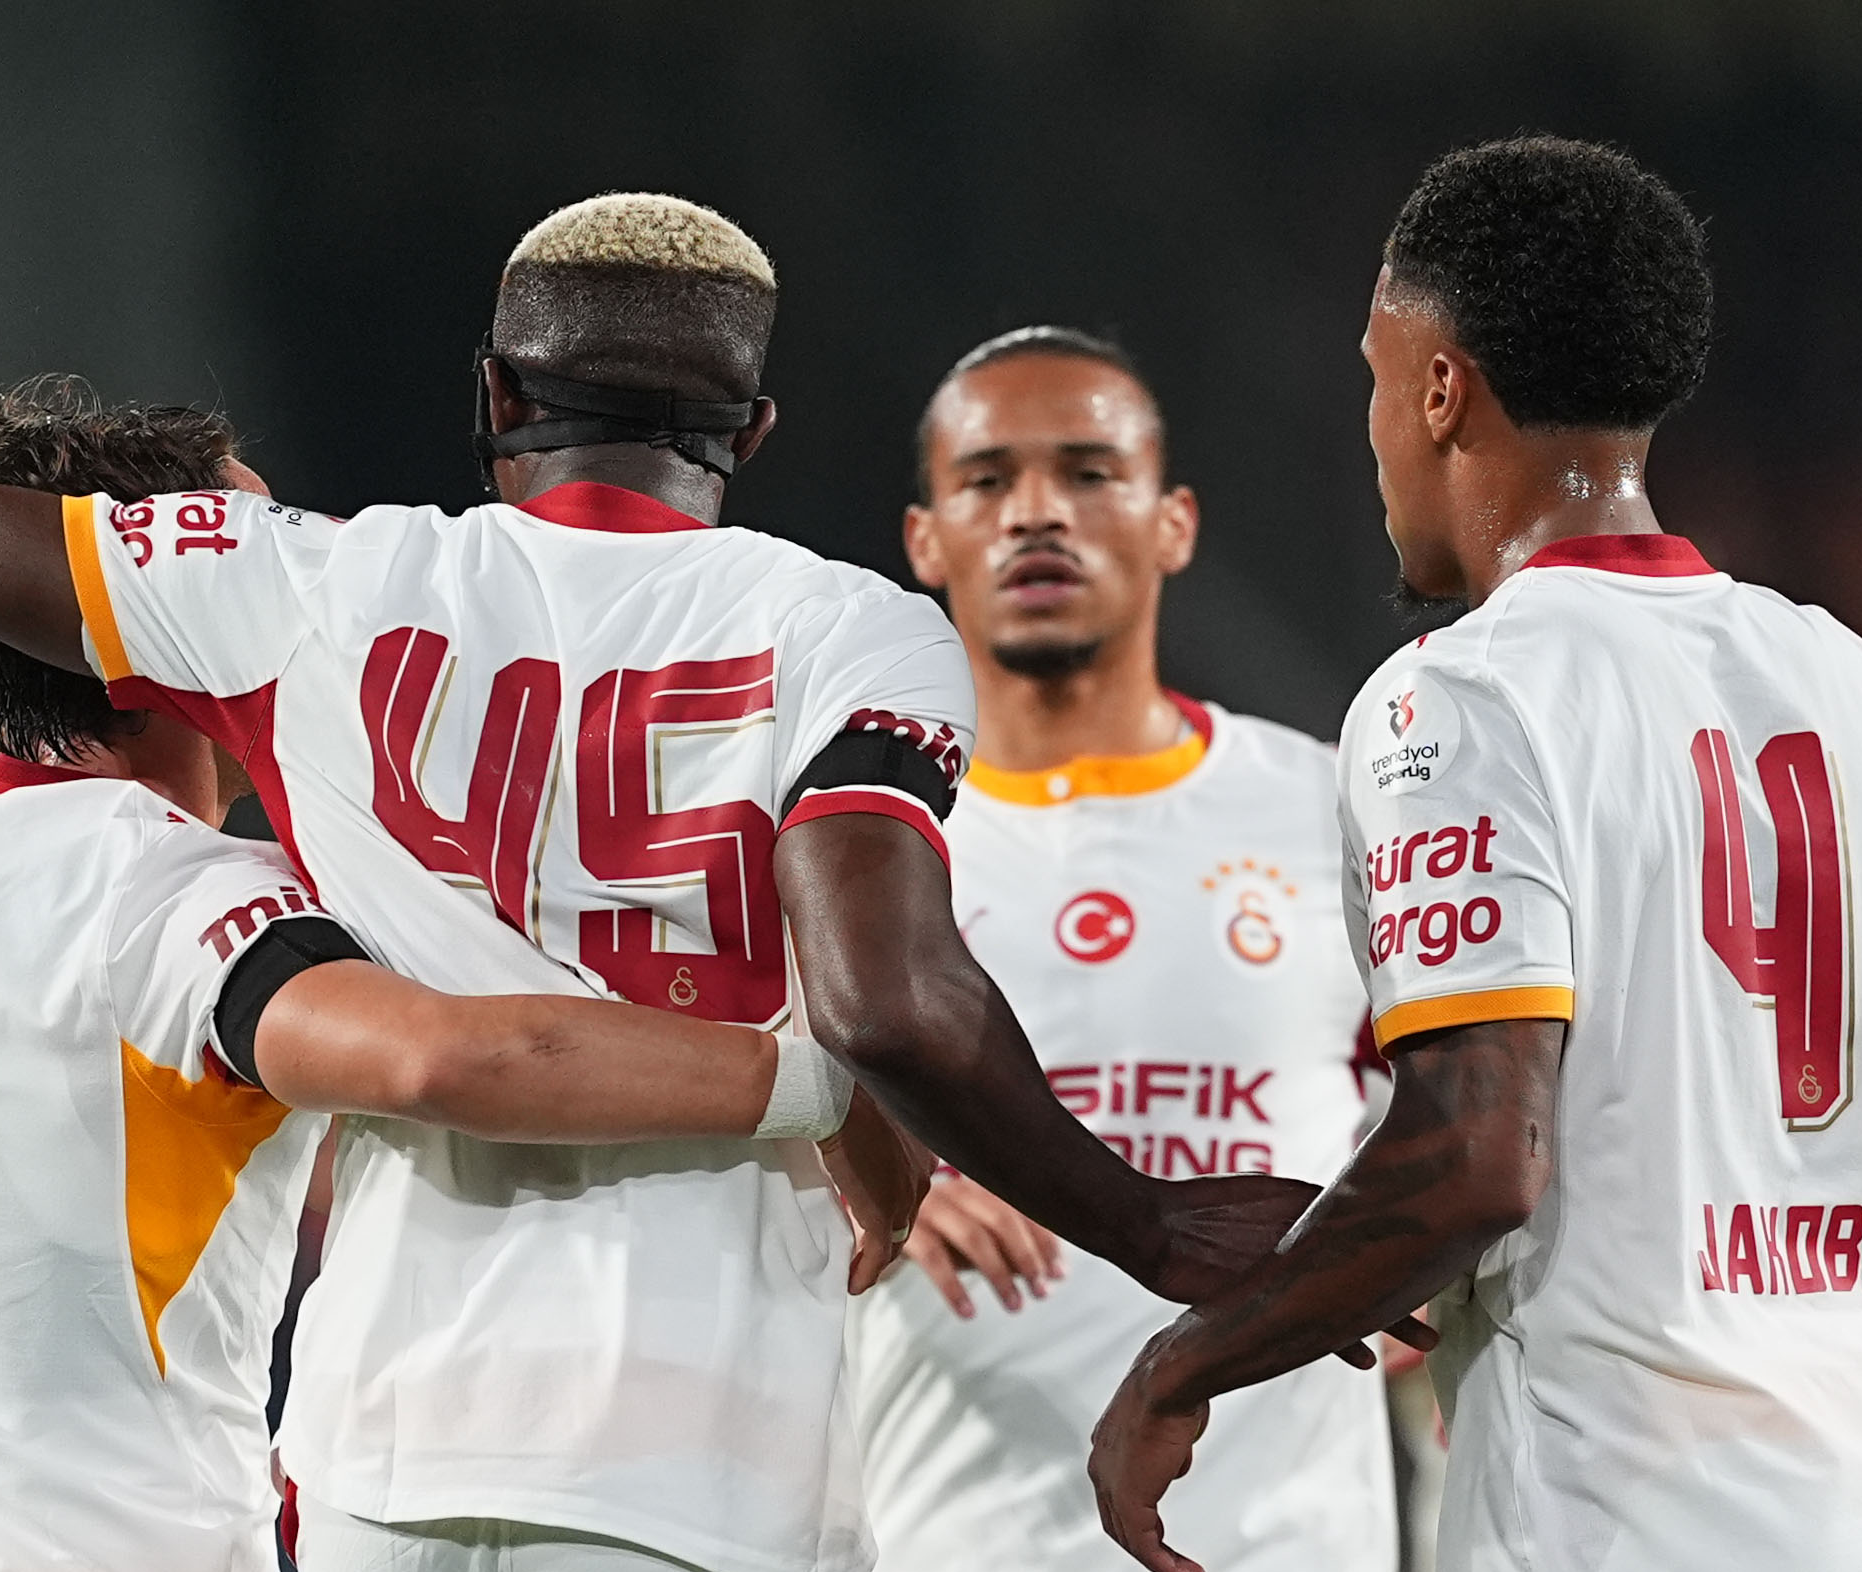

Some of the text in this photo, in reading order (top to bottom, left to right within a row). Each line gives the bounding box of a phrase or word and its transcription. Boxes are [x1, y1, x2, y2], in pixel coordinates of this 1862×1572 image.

[360, 626, 792, 1031] 45
[1372, 742, 1439, 774] trendyol
[1690, 728, 1856, 1133] 4
